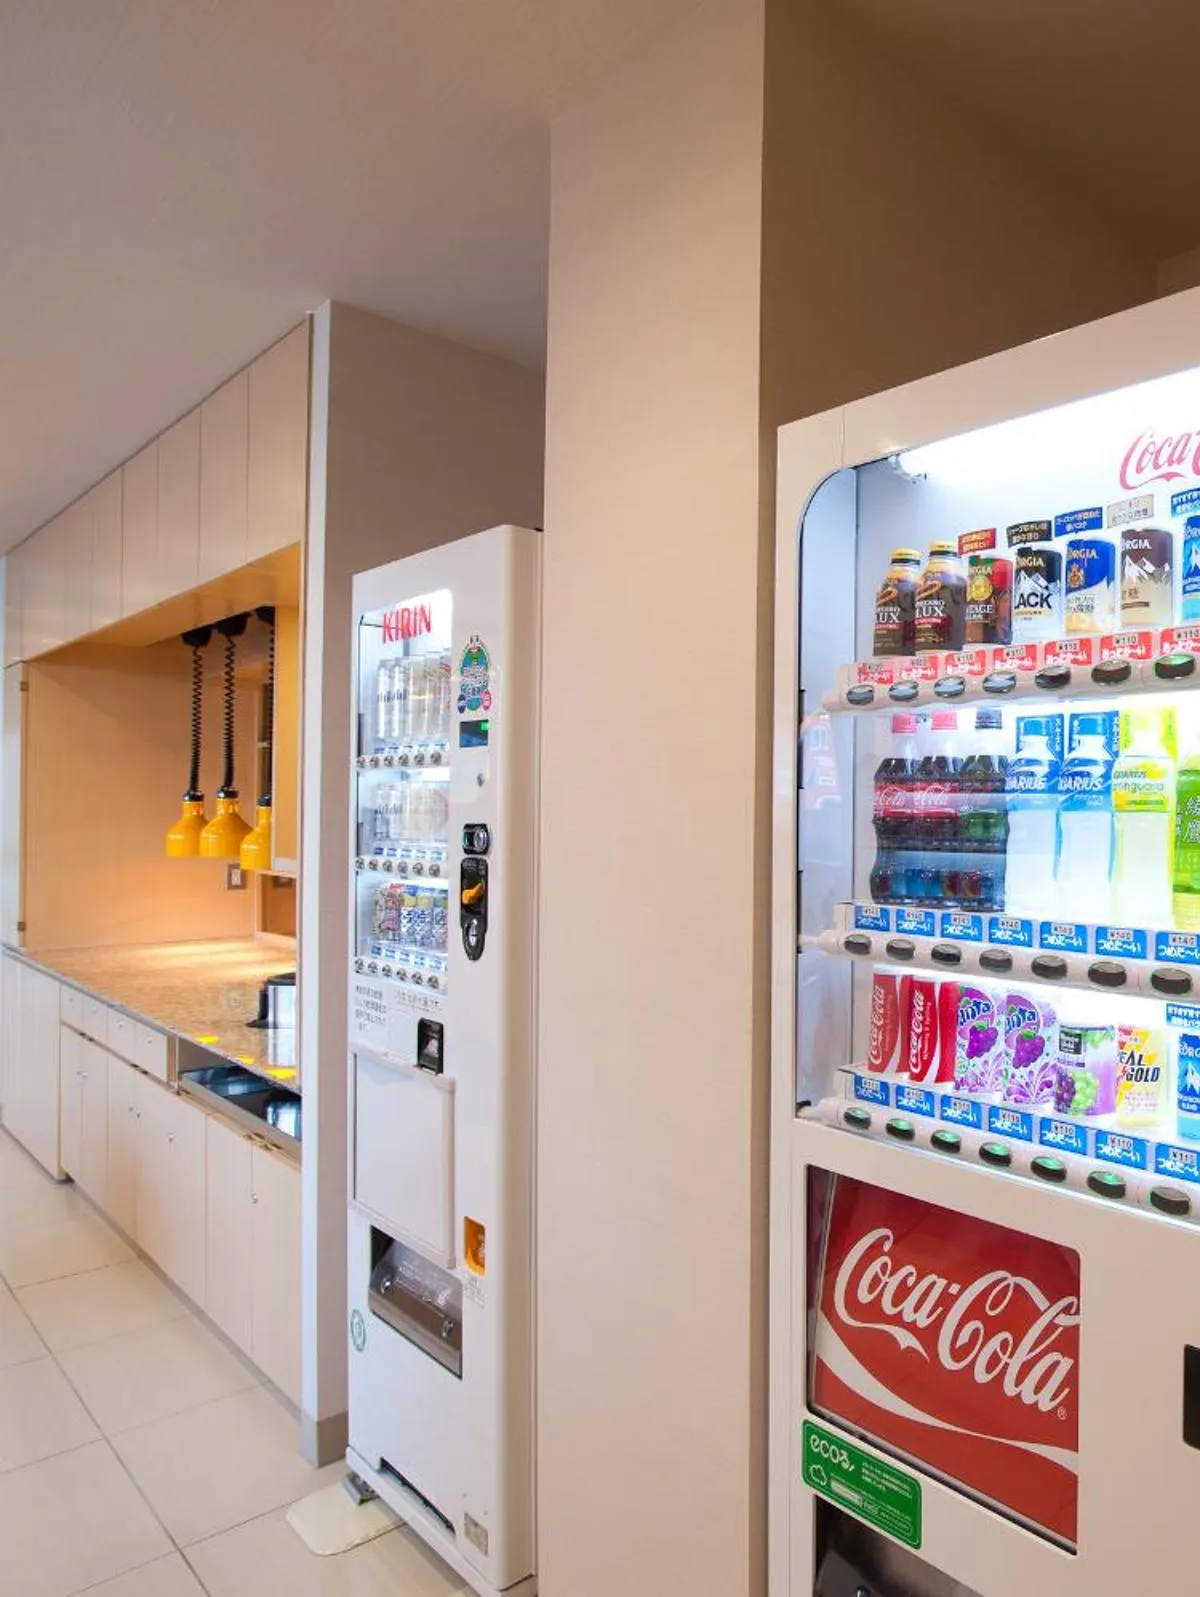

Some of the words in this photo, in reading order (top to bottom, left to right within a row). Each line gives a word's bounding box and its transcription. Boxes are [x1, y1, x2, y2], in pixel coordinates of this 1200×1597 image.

[382, 605, 431, 643] KIRIN
[959, 999, 992, 1027] anta
[1118, 1050, 1146, 1067] EAL
[1126, 1066, 1160, 1082] GOLD
[834, 1228, 1080, 1413] Coca-Cola
